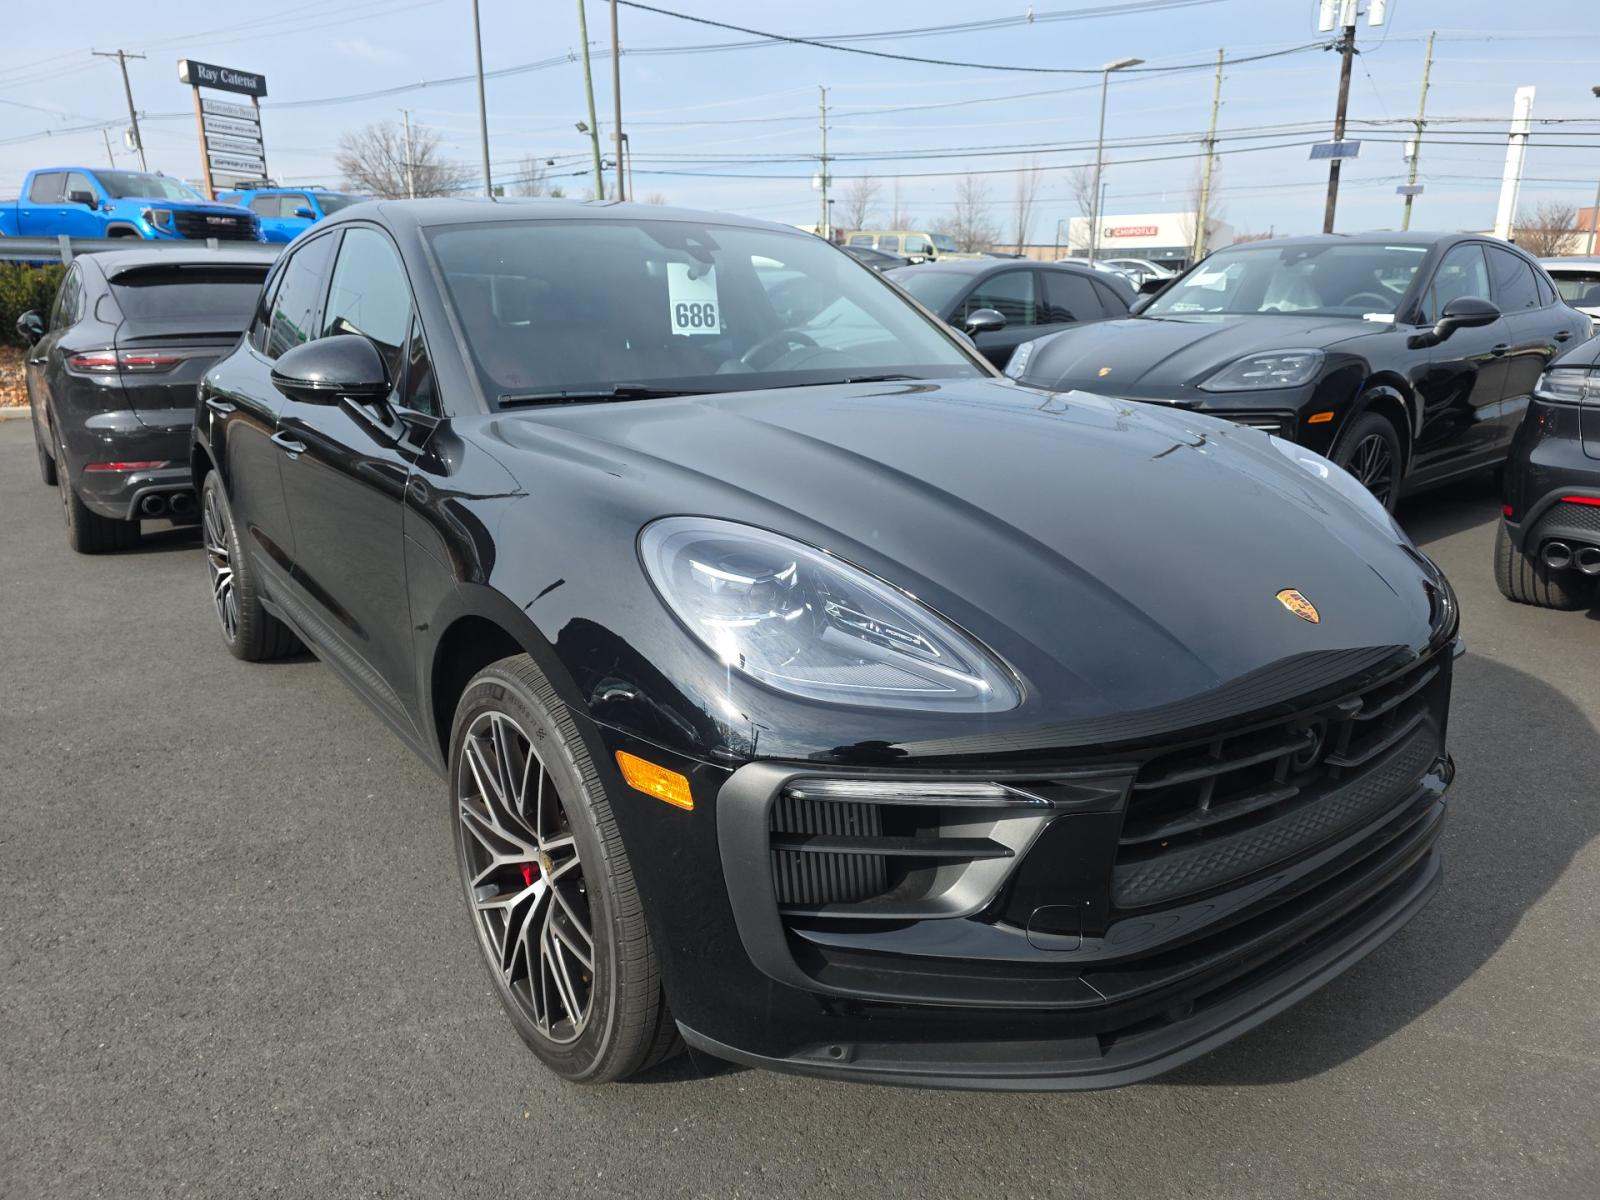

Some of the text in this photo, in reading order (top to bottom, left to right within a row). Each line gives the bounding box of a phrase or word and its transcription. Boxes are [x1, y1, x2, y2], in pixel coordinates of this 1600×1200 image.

[197, 65, 257, 88] Ray Catena
[676, 303, 716, 328] 686
